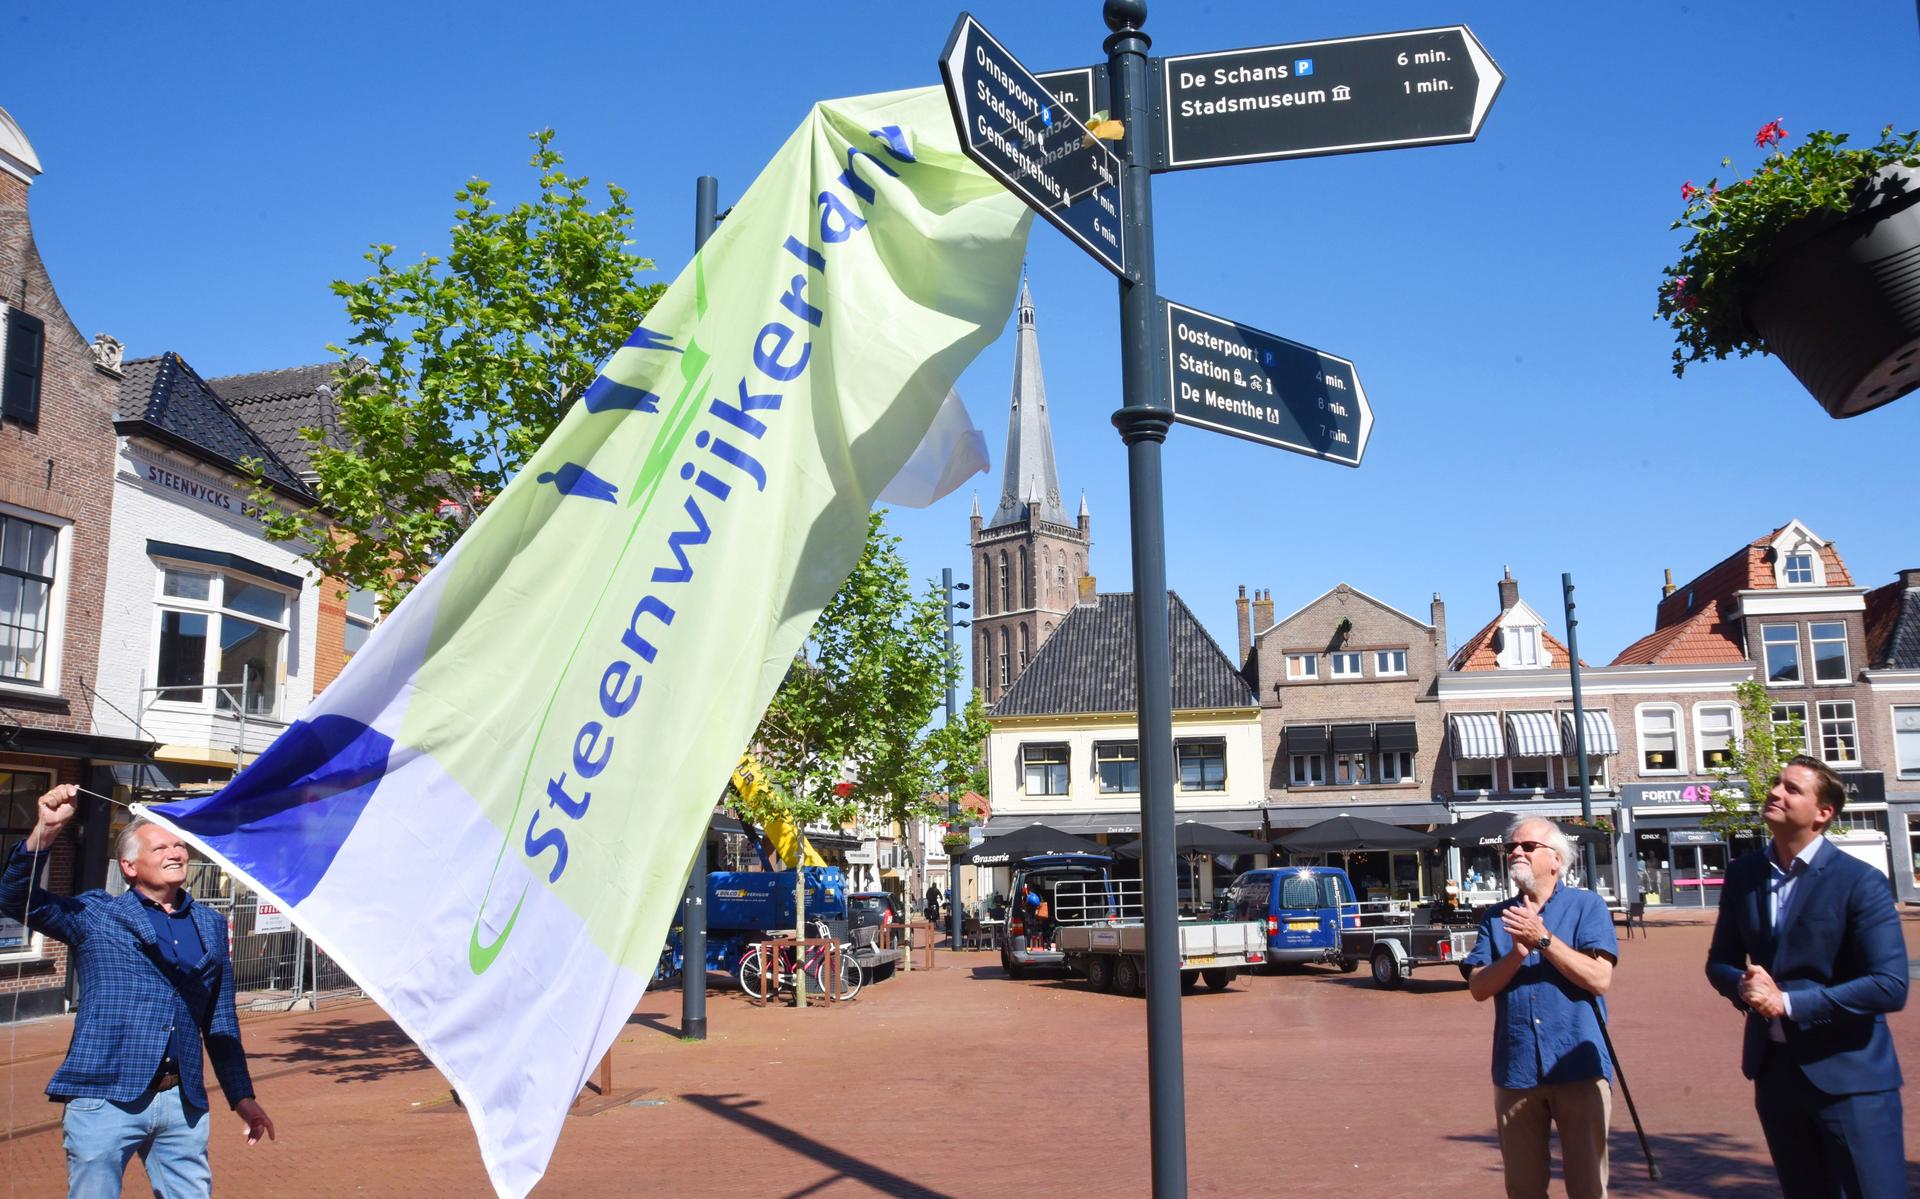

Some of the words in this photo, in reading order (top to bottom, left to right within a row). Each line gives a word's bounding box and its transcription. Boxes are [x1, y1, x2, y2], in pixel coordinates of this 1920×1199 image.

[1180, 72, 1206, 89] De
[1214, 64, 1288, 86] Schans
[1397, 52, 1409, 66] 6
[1414, 49, 1451, 64] min.
[976, 46, 1038, 116] Onnapoort
[1091, 156, 1097, 170] 3
[1099, 164, 1116, 188] min.
[1181, 89, 1326, 117] Stadsmuseum
[1404, 81, 1411, 94] 1
[1417, 78, 1454, 93] min.
[977, 80, 1036, 146] Stadstuin
[1092, 187, 1098, 201] 4
[1100, 194, 1117, 218] min.
[977, 115, 1061, 199] Gemeentehuis
[1094, 218, 1100, 232] 6
[1102, 225, 1118, 248] min.
[1178, 323, 1259, 364] Oosterpoort
[1316, 371, 1322, 383] 4
[1325, 374, 1347, 390] min.
[1179, 353, 1231, 383] Station
[1327, 402, 1349, 417] min.
[1181, 382, 1200, 403] De
[1205, 389, 1264, 420] Meenthe
[1329, 429, 1350, 445] min.
[149, 466, 230, 509] STEENWYCKS
[1642, 790, 1681, 801] FORTY
[1683, 784, 1712, 802] 49
[973, 852, 1009, 864] Brasserie
[1479, 835, 1503, 845] Lunch
